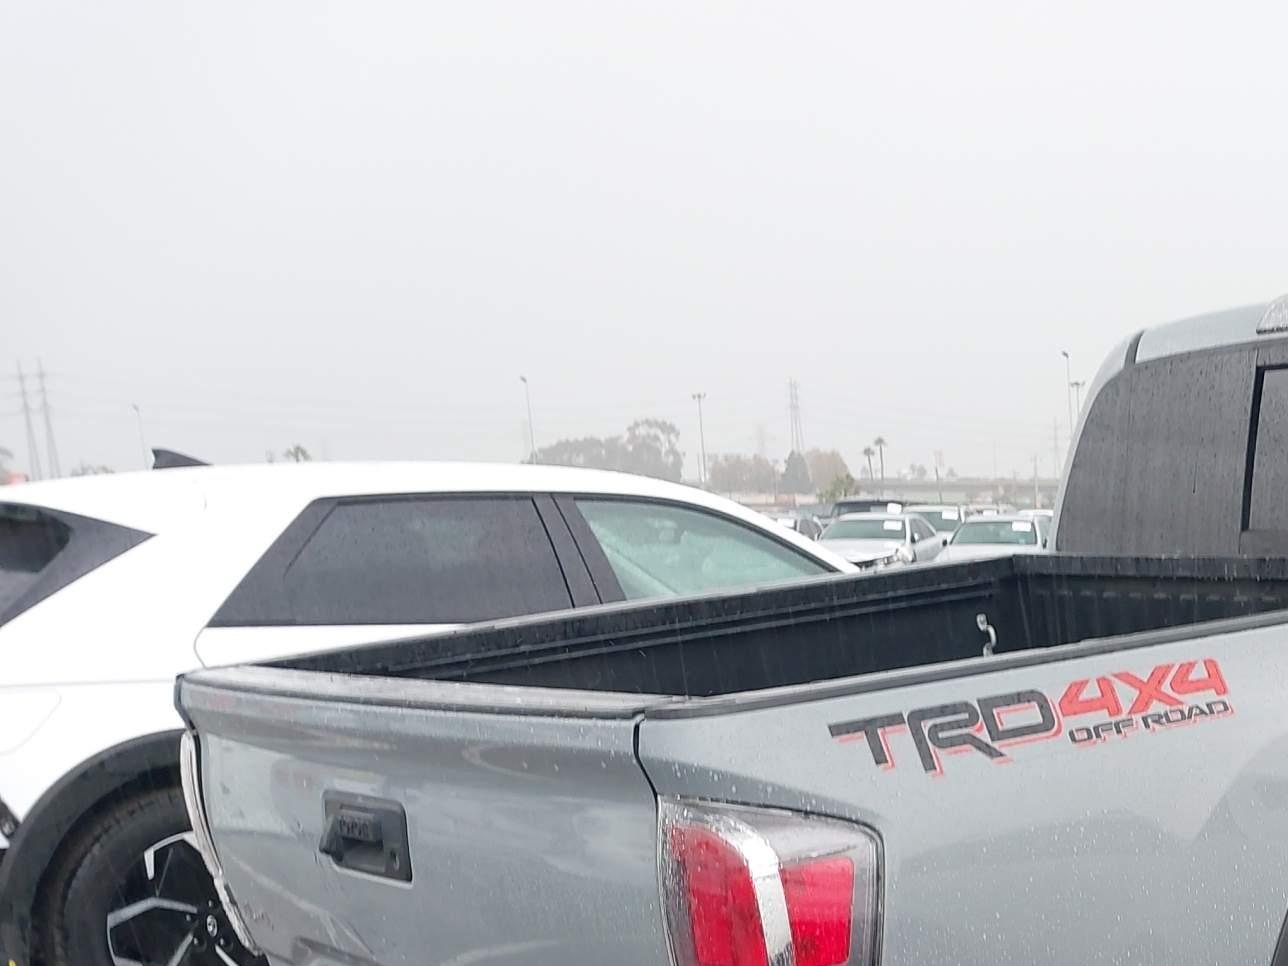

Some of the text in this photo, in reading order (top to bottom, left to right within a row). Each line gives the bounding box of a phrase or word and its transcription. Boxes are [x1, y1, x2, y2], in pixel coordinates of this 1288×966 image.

[828, 688, 1062, 776] TRD
[1068, 699, 1234, 746] OFF ROAD
